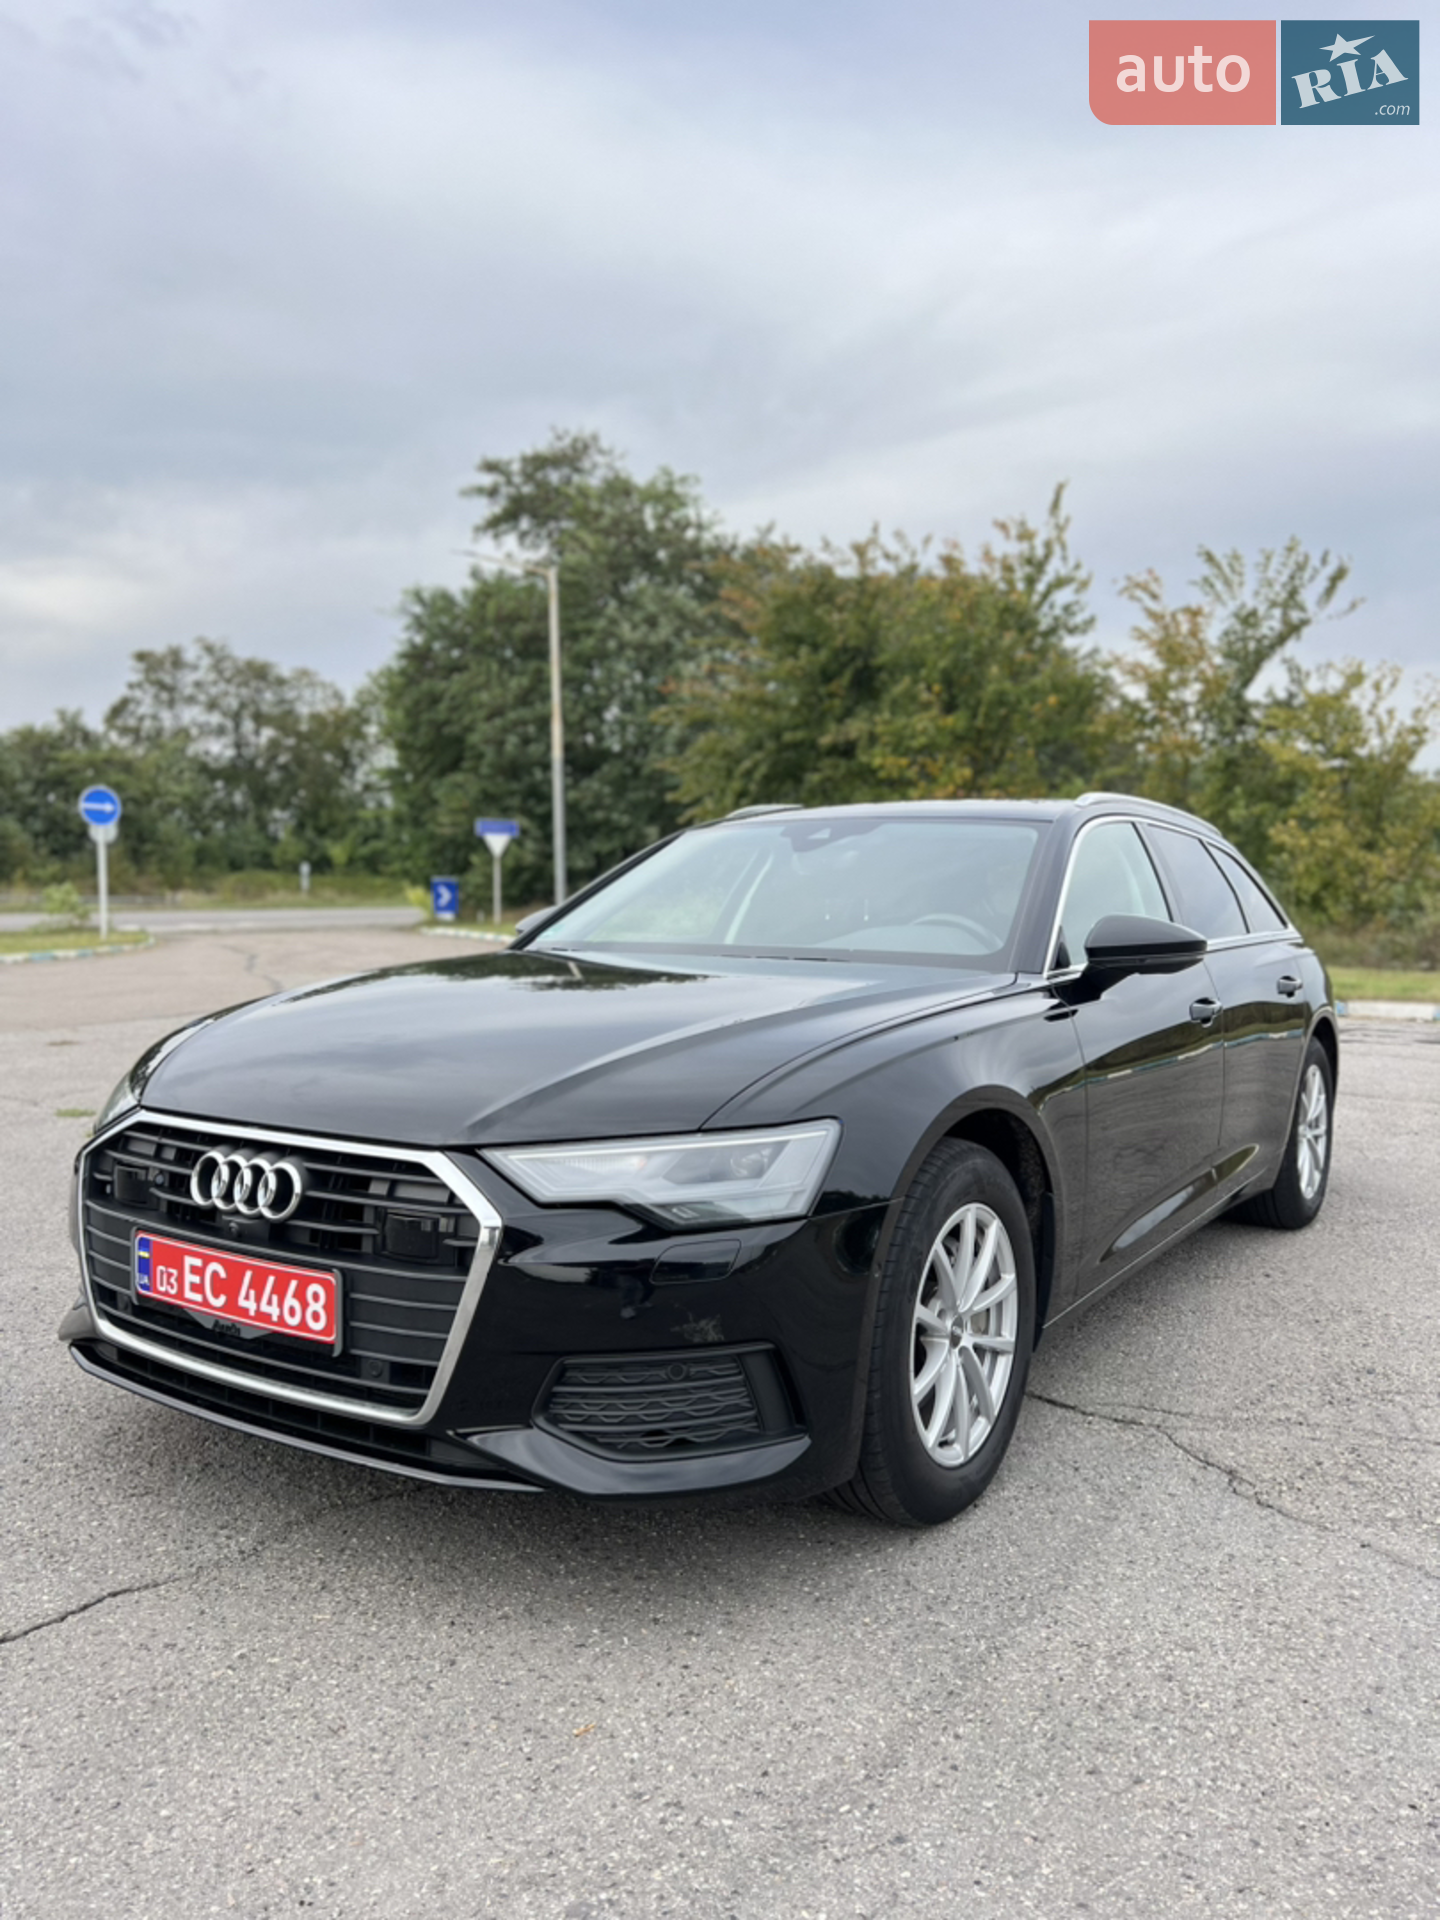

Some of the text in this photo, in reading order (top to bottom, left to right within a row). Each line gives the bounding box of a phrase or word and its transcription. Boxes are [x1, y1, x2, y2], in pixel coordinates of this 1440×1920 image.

[156, 1256, 327, 1332] 03 EC 4468
